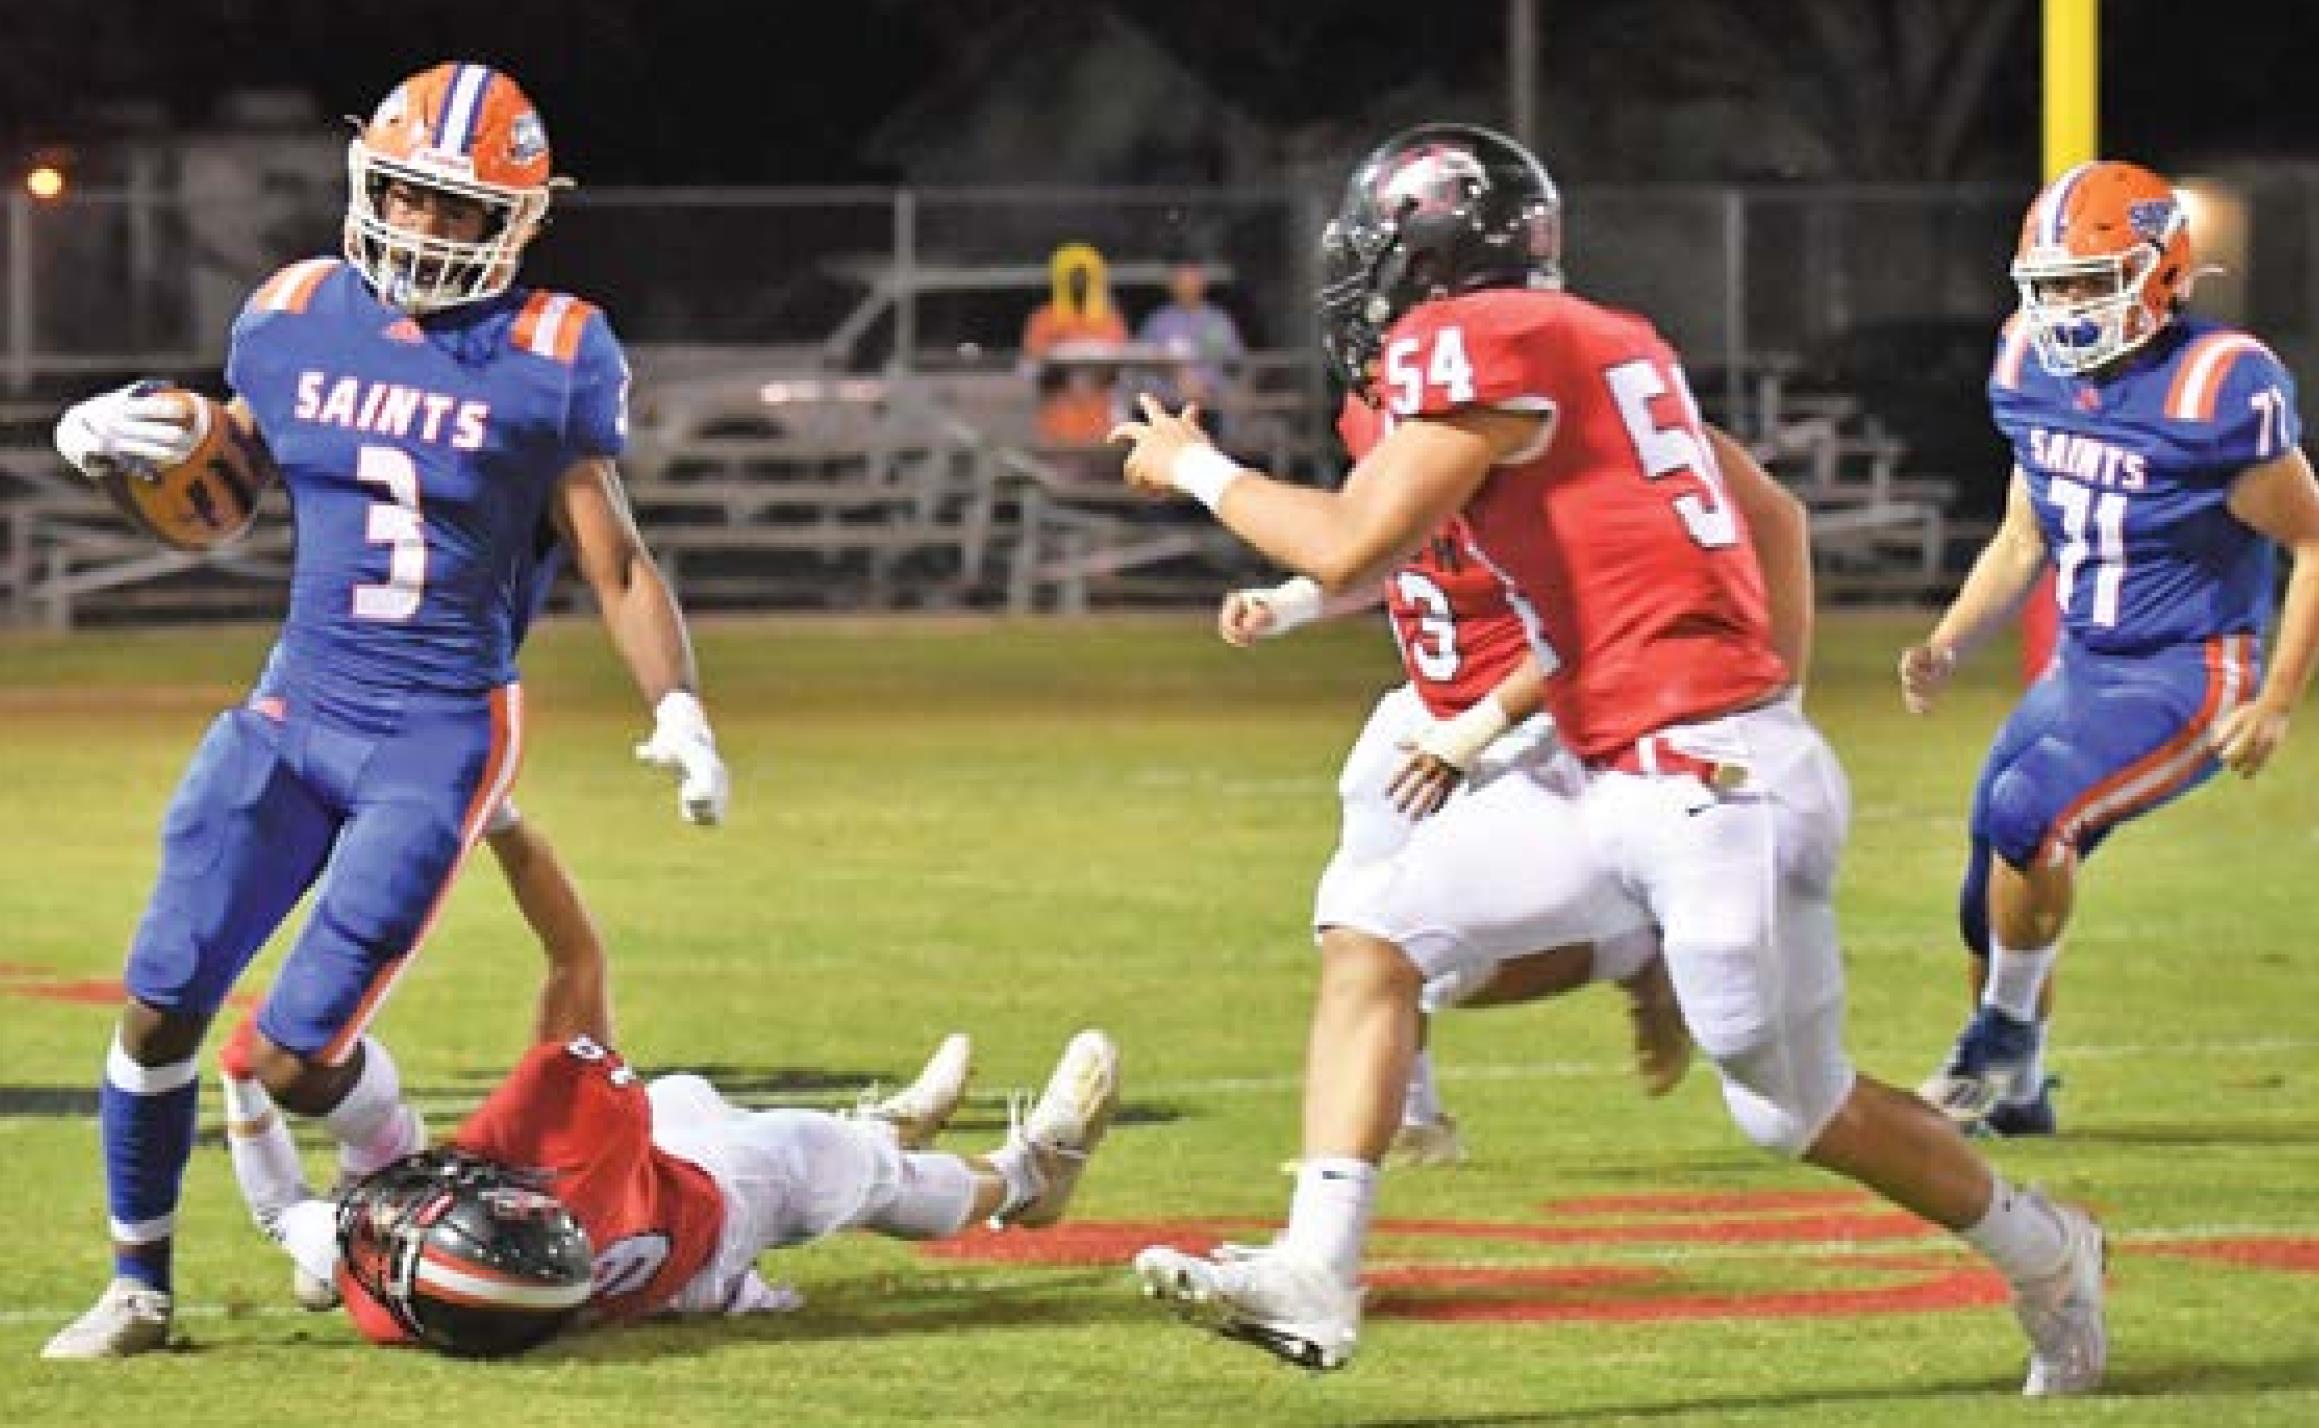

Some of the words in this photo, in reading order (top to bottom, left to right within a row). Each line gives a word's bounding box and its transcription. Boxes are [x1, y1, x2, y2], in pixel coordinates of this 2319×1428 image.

[294, 370, 492, 451] SAINTS
[1386, 325, 1475, 415] 54
[1603, 359, 1738, 547] 5
[2029, 427, 2149, 491] SAINTS
[352, 443, 428, 621] 3
[2048, 475, 2128, 627] 71
